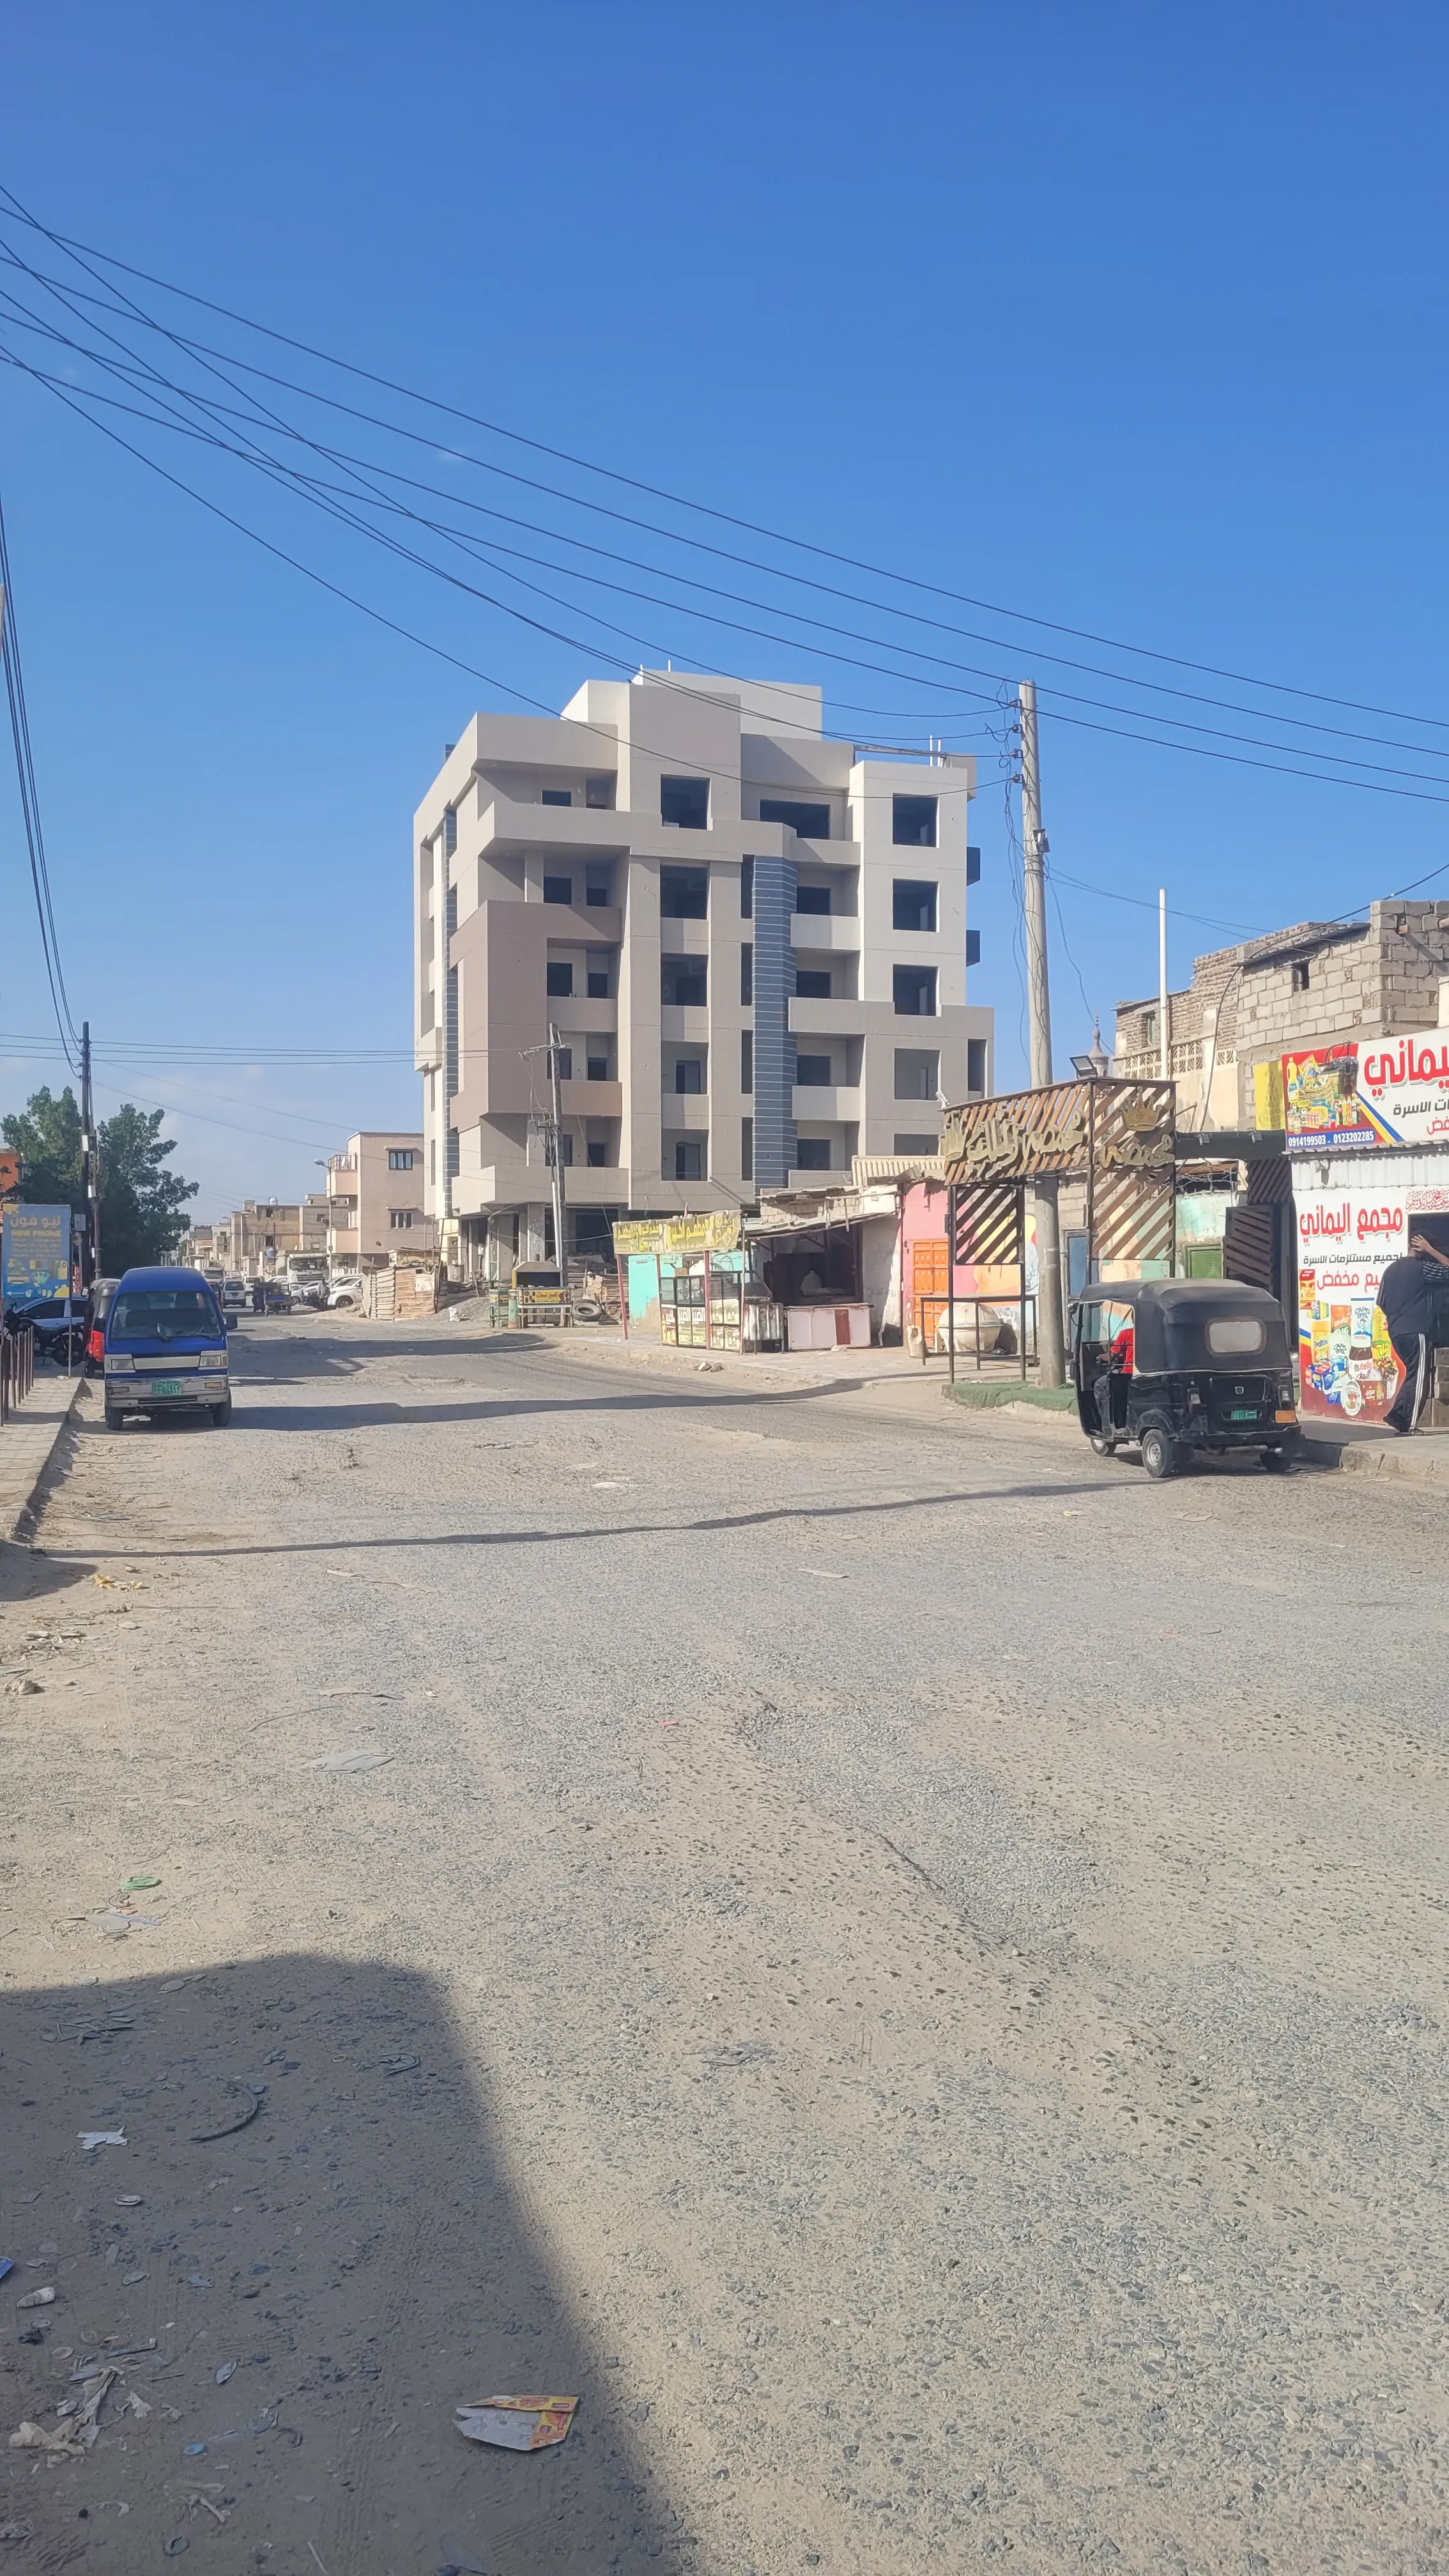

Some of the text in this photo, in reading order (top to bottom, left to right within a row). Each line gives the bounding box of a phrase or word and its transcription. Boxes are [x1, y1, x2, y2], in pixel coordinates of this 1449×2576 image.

[1393, 1101, 1431, 1118] الاسرة
[1288, 1135, 1326, 1147] 0914199503
[1333, 1131, 1374, 1144] 0123202285
[1300, 1202, 1403, 1243] مجمع اليماني
[1303, 1255, 1327, 1267] الاسرة
[1329, 1253, 1372, 1266] مستلزمات
[1317, 1269, 1381, 1293] يع مخفض
